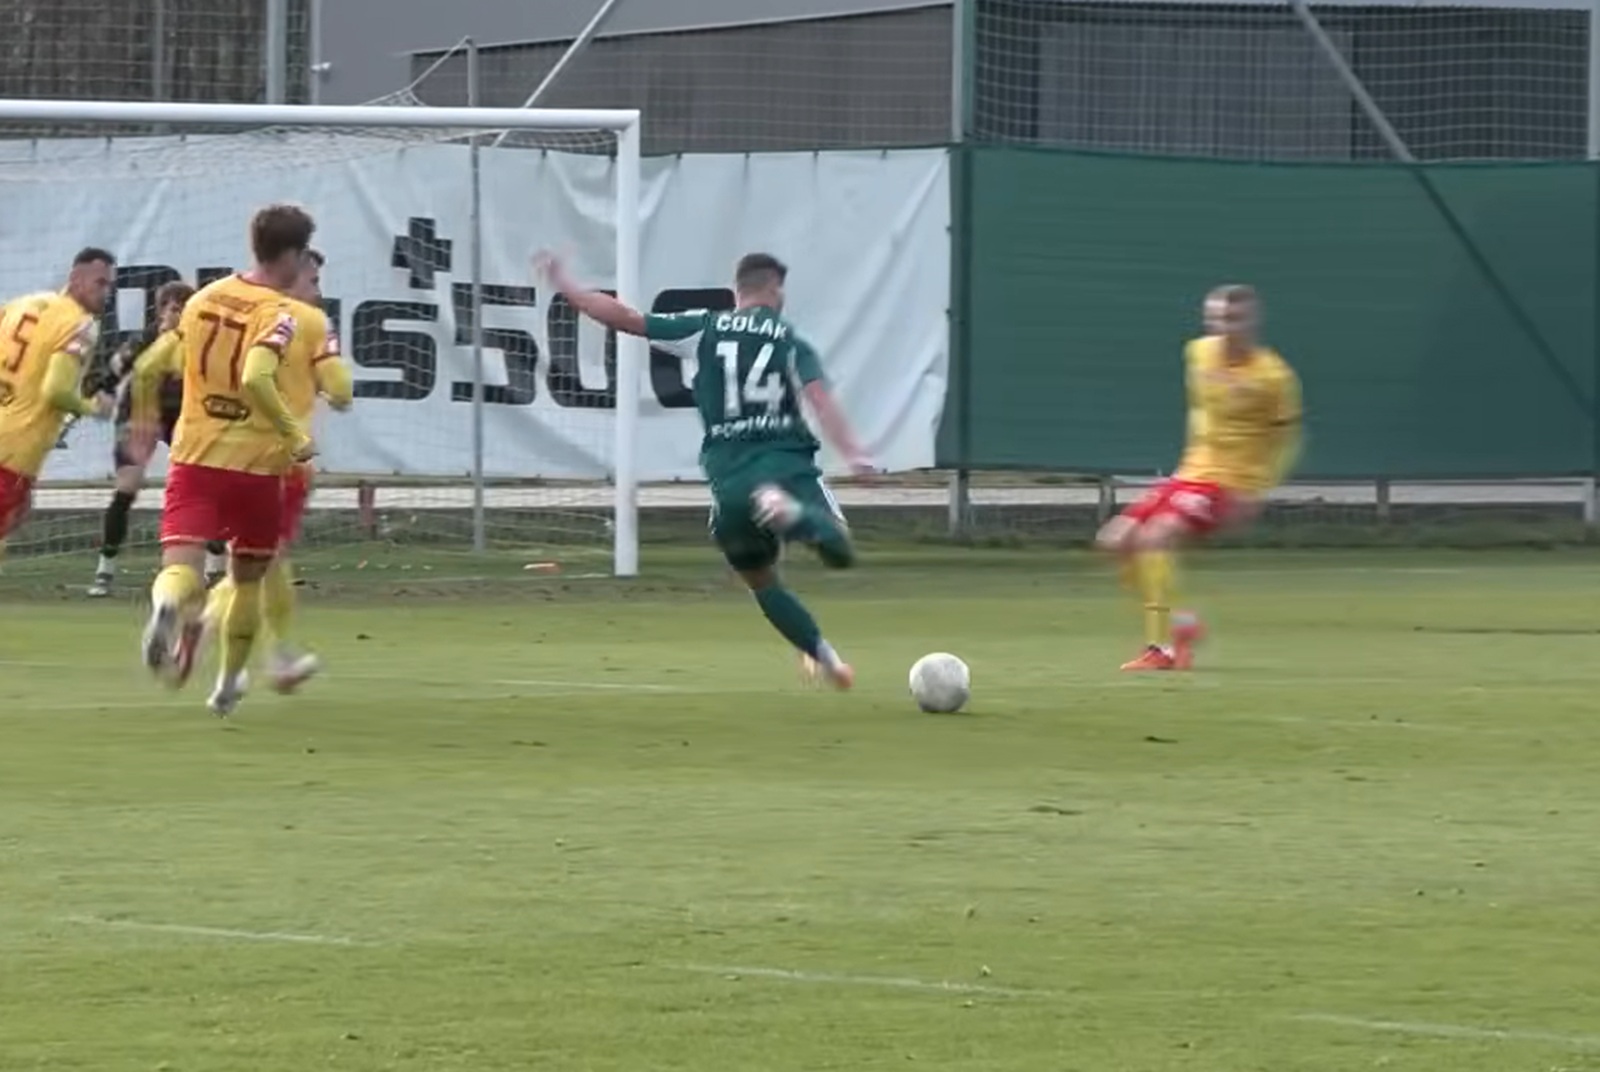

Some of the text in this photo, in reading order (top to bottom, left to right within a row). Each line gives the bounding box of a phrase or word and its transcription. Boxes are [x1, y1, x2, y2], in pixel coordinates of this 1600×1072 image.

[9, 313, 38, 373] 5
[197, 309, 246, 392] 77
[715, 341, 786, 418] 14
